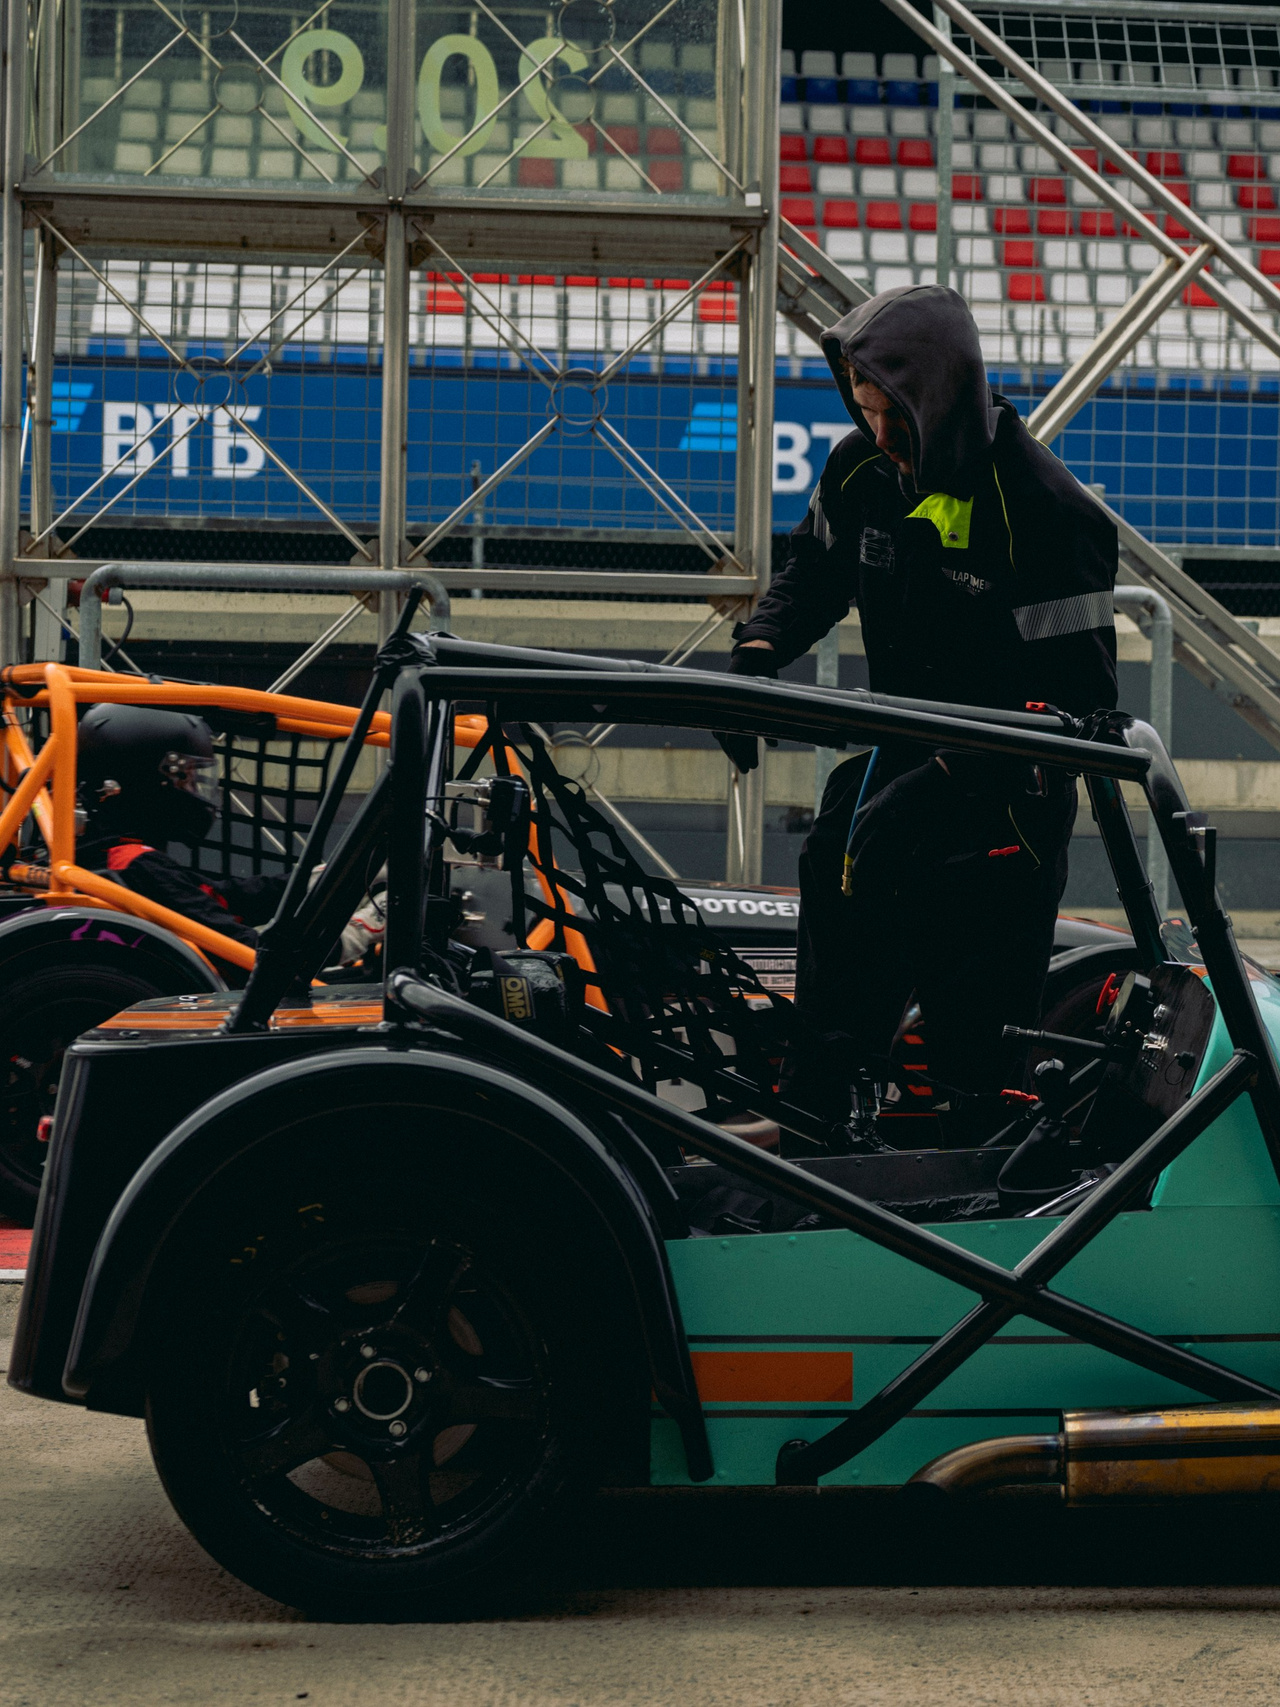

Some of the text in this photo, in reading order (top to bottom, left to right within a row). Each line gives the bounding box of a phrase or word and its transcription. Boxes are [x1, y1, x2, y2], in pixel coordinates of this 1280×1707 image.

[103, 401, 266, 478] ВТБ
[773, 421, 858, 493] ВТ
[953, 570, 969, 582] LAP
[505, 977, 526, 1019] OMP
